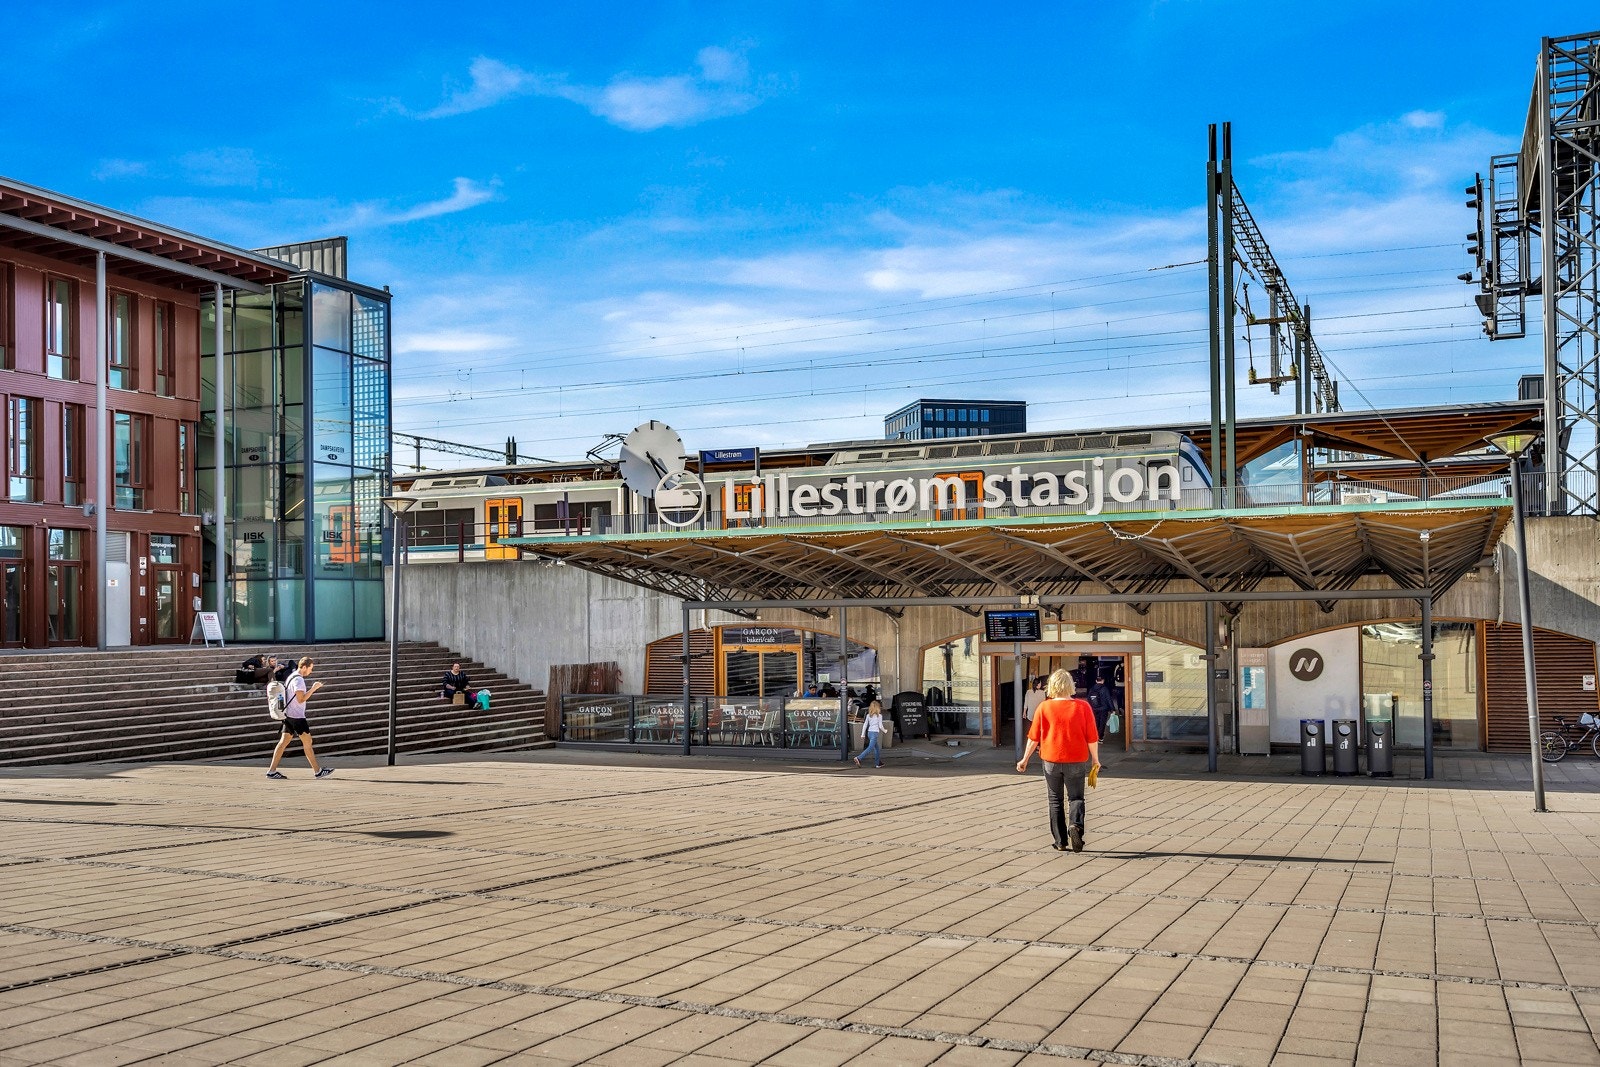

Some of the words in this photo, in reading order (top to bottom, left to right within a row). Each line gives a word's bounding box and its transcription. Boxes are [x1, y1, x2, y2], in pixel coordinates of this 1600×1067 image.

[714, 451, 742, 459] Lillestrøm
[724, 472, 966, 519] Lillestrøm
[983, 457, 1182, 516] stasjon
[742, 628, 779, 636] GARÇON
[579, 706, 612, 714] GARÇON
[650, 707, 685, 716] GARÇON
[793, 710, 831, 720] GARÇON
